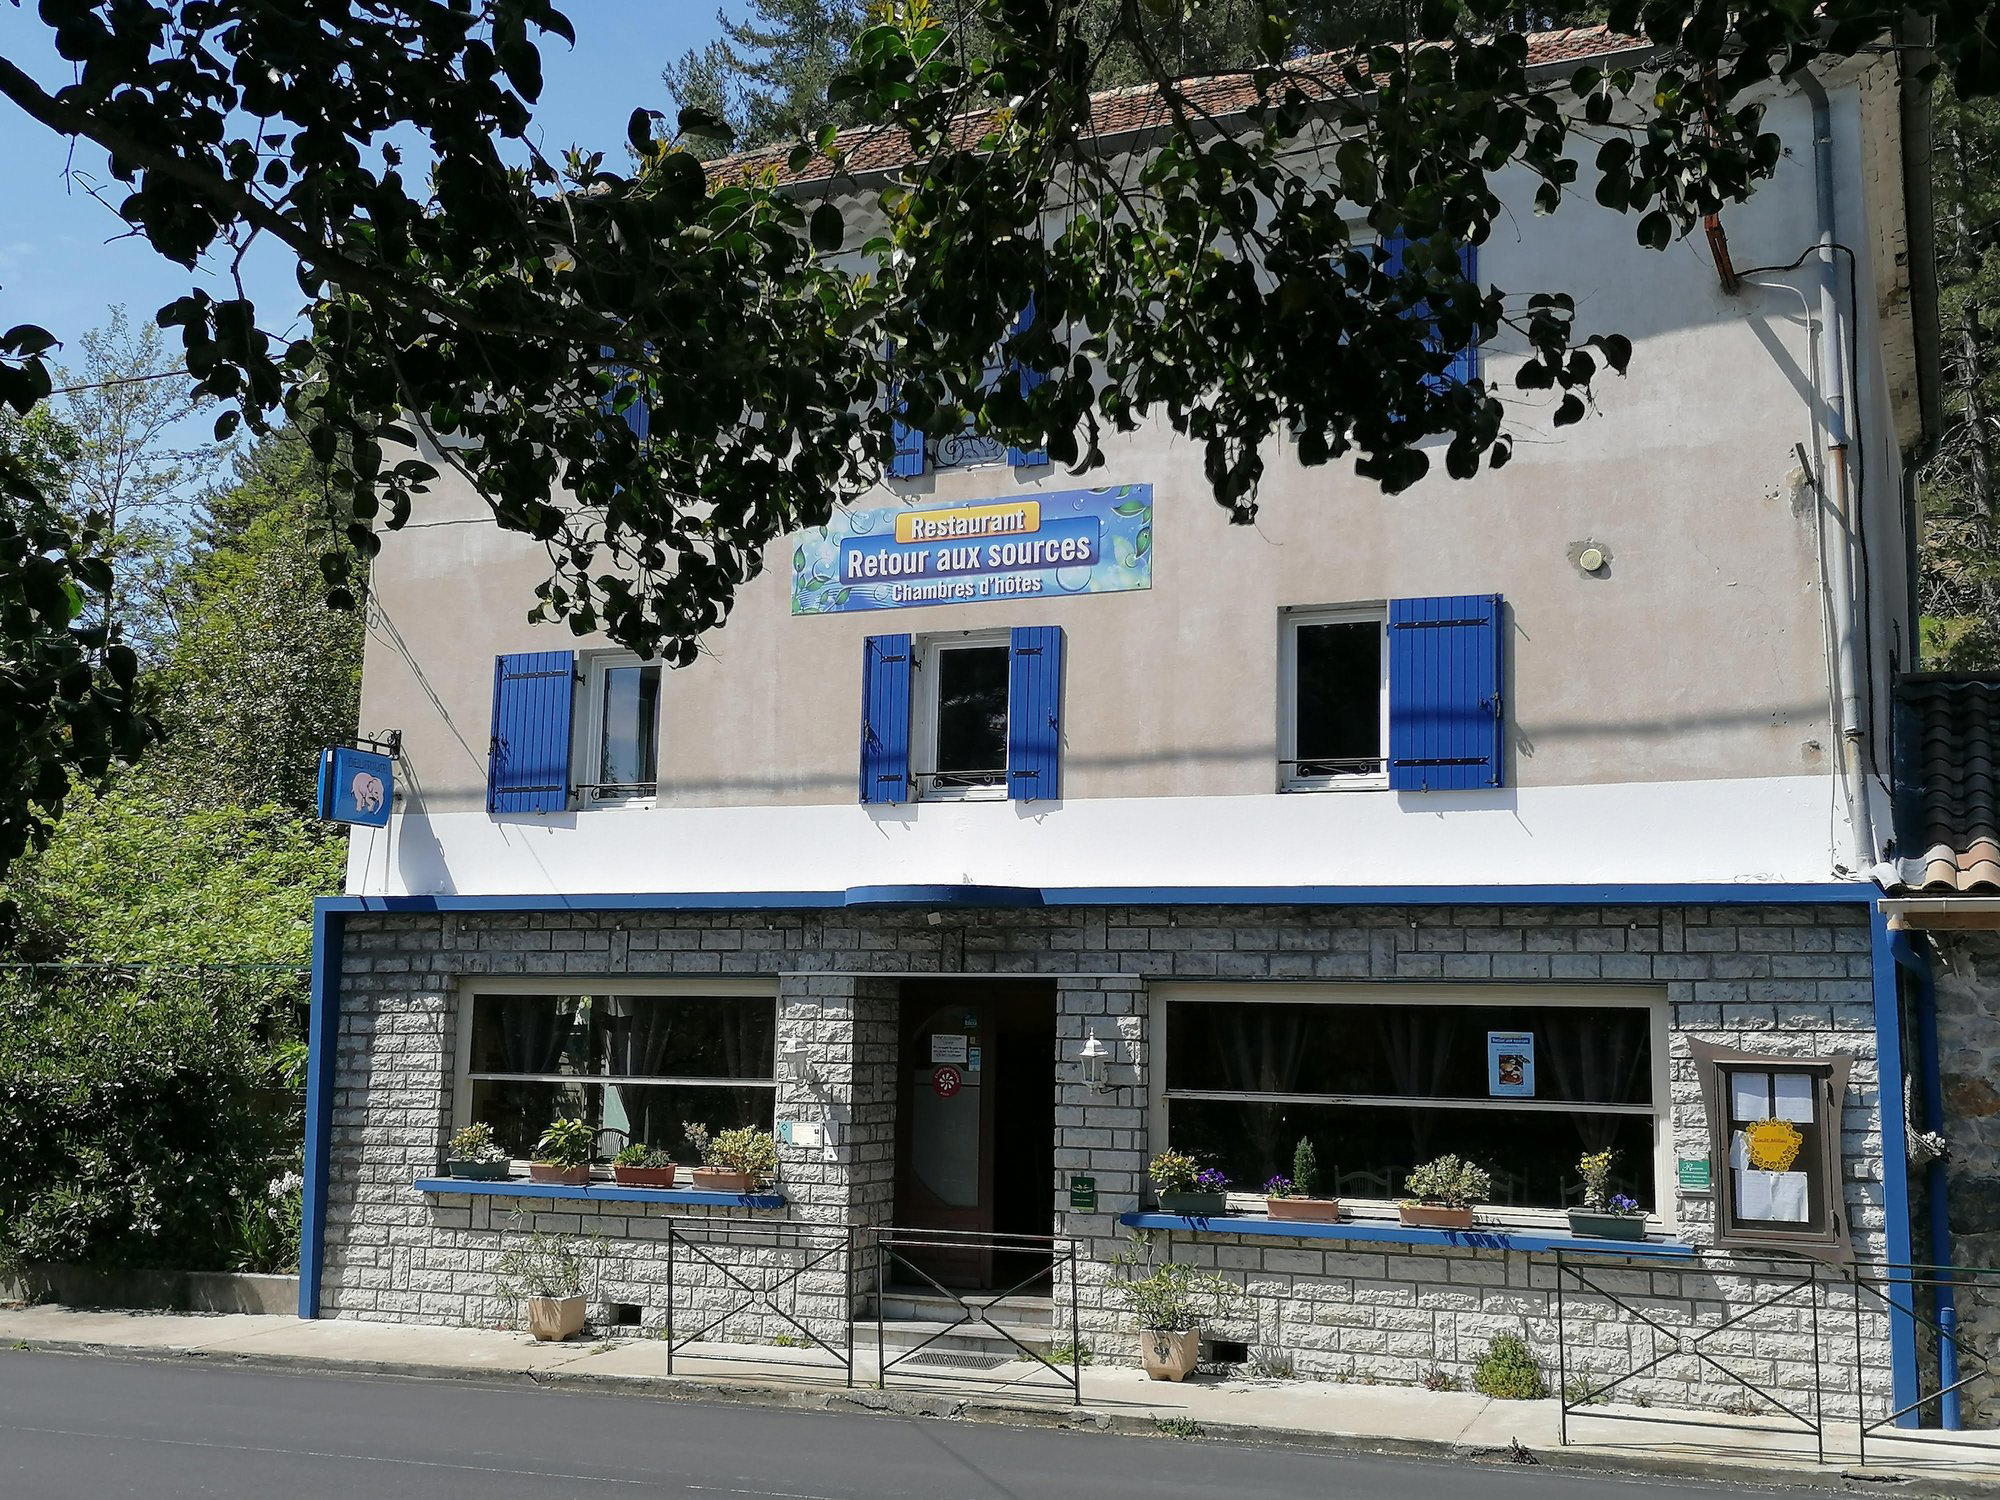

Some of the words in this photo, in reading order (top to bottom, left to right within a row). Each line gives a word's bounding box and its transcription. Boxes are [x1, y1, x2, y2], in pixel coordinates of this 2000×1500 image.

[910, 509, 1026, 540] Restaurant
[847, 548, 929, 579] Retour
[935, 544, 982, 572] aux
[987, 535, 1091, 567] sources
[891, 580, 976, 602] Chambres
